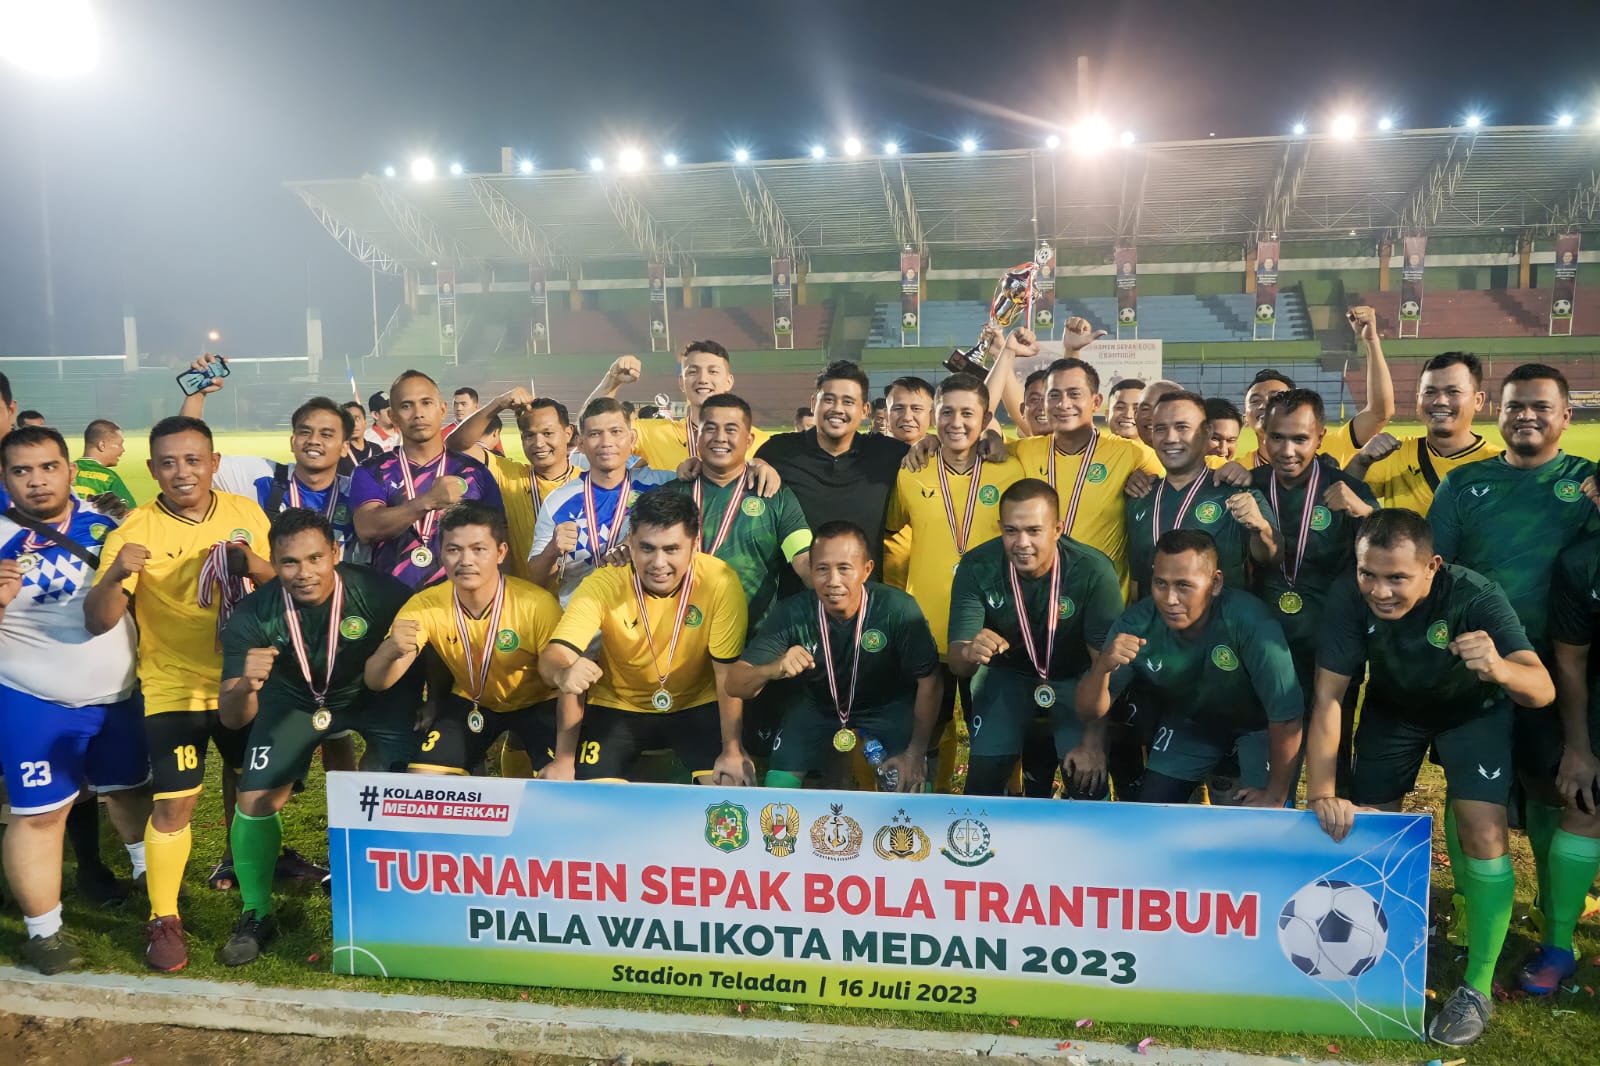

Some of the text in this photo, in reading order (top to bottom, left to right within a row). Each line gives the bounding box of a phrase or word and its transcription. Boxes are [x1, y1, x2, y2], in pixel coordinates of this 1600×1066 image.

[973, 715, 982, 738] 9
[1152, 726, 1174, 752] 21
[421, 730, 441, 752] 3
[579, 740, 601, 765] 13
[173, 744, 198, 772] 18
[249, 745, 272, 771] 13
[19, 760, 53, 788] 23
[383, 787, 482, 803] KOLABORASI
[383, 802, 508, 819] MEDAN BERKAH
[368, 850, 1258, 938] TURNAMEN SEPAK BOLA TRANTIBUM
[469, 908, 1137, 985] PIALA WALIKOTA MEDAN 2023
[611, 964, 703, 988] Stadion
[708, 970, 808, 995] Teladan
[838, 979, 863, 999] 16
[867, 980, 911, 1001] Juli
[916, 984, 978, 1005] 2023
